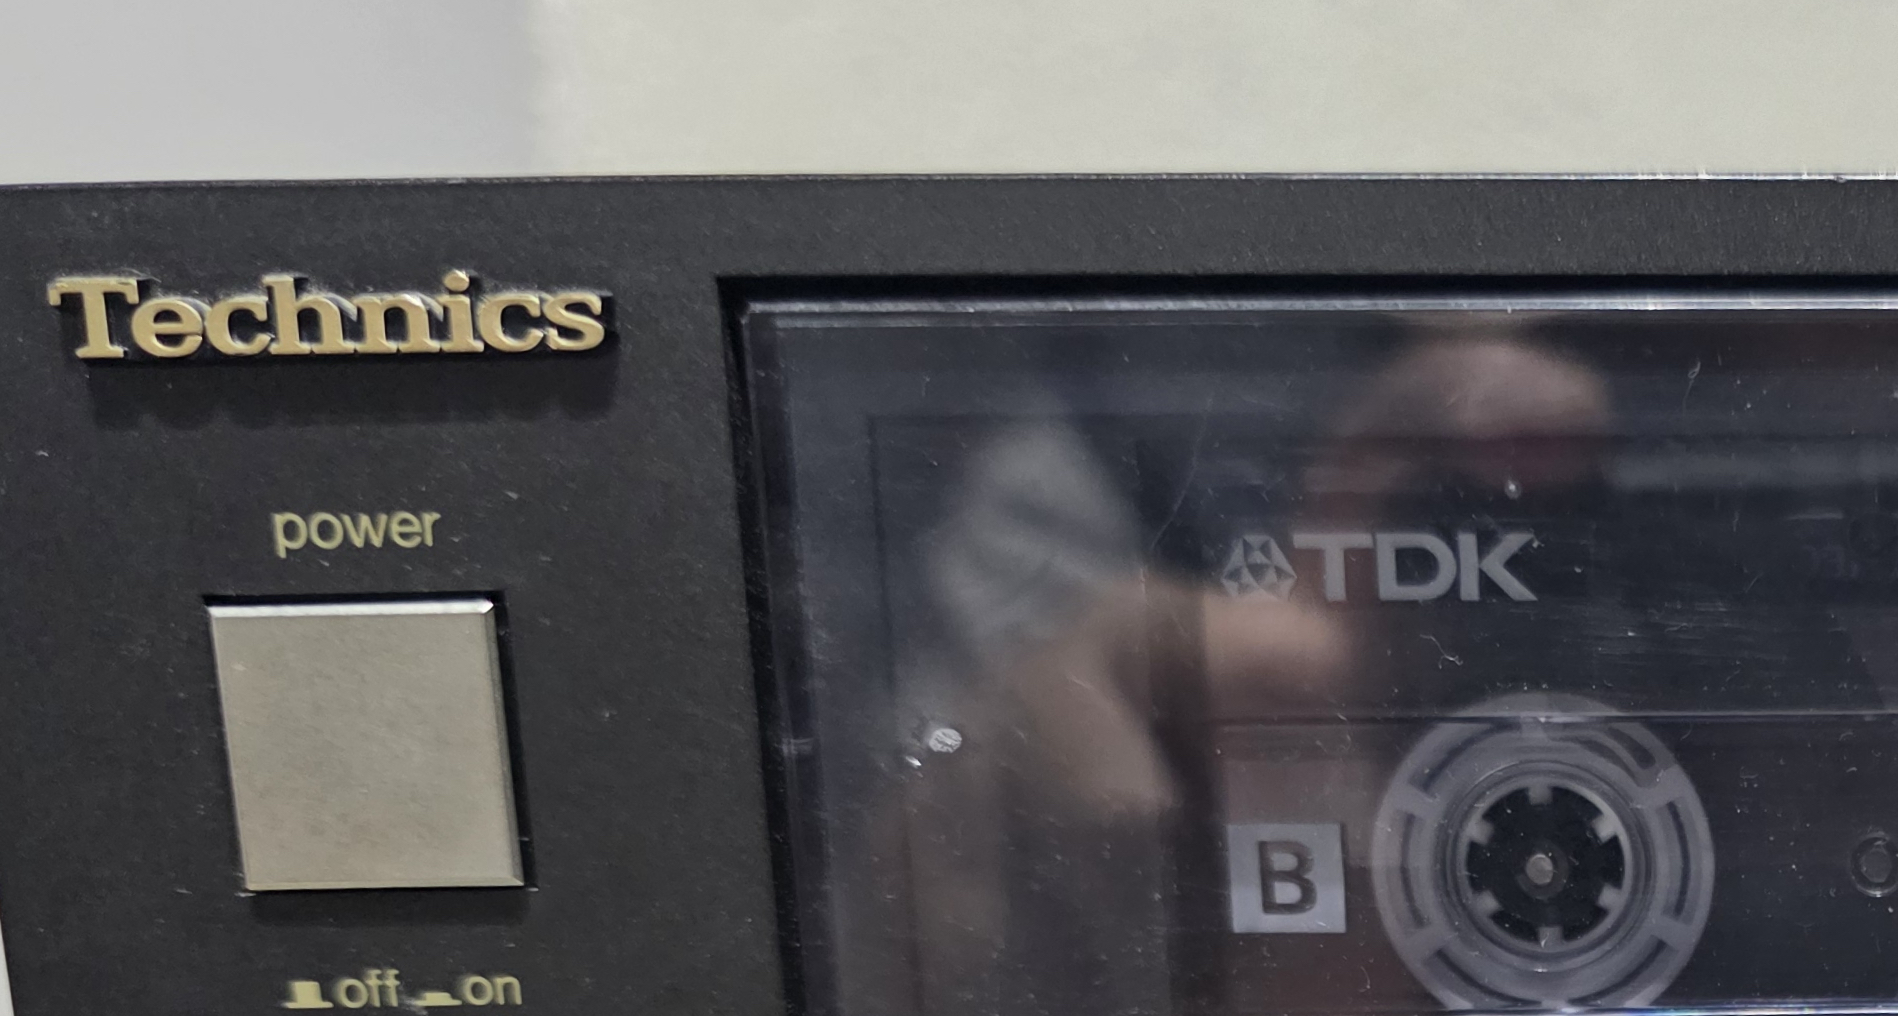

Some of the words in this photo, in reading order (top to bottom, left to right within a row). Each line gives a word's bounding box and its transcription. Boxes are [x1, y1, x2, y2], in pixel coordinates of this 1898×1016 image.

[46, 268, 608, 360] Technics
[272, 510, 441, 559] power
[1293, 531, 1538, 602] TDK
[1257, 840, 1318, 915] B
[338, 968, 401, 1009] off
[461, 975, 522, 1006] on
